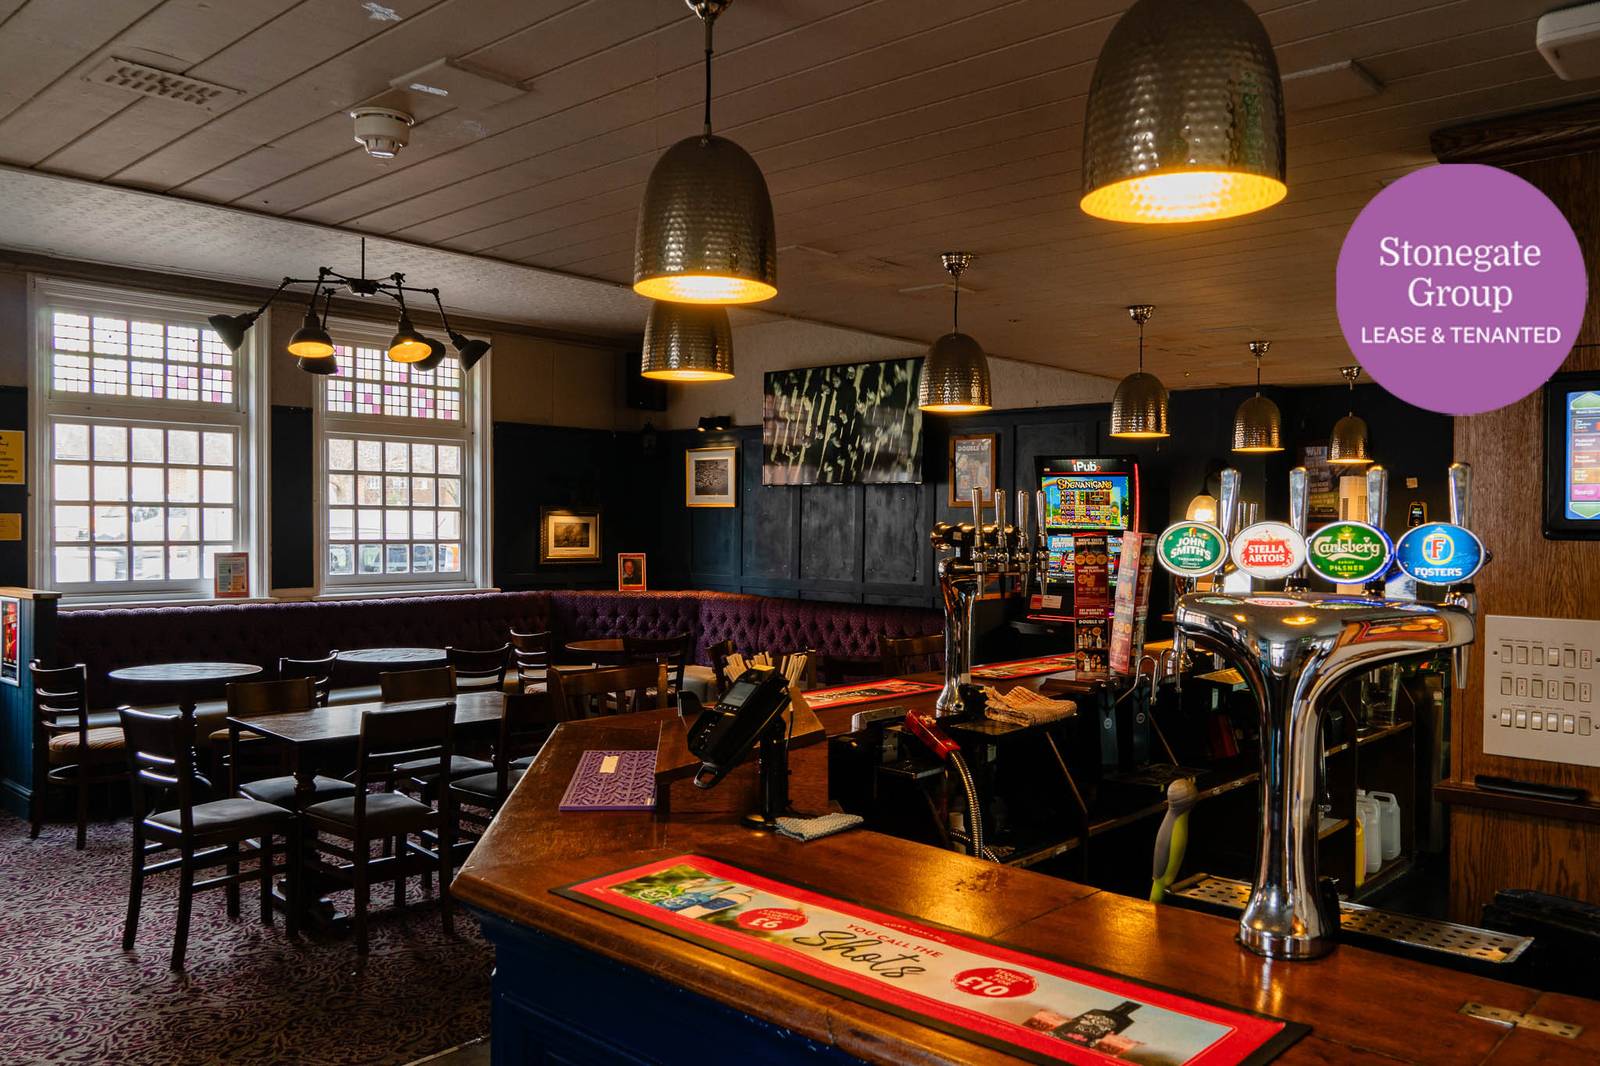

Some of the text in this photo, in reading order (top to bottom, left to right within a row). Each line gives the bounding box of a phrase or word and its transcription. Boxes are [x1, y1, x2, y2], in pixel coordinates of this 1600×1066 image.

[1176, 536, 1206, 548] JOHN
[1248, 544, 1286, 554] STELLA
[1313, 536, 1381, 561] Carlsberg
[1431, 539, 1445, 559] F
[1170, 545, 1212, 561] SMITH'S
[1248, 553, 1286, 563] ARTOIS
[748, 917, 780, 930] £6
[846, 923, 944, 959] YOU CALL THE
[793, 930, 927, 979] Shots
[957, 976, 1010, 996] £10
